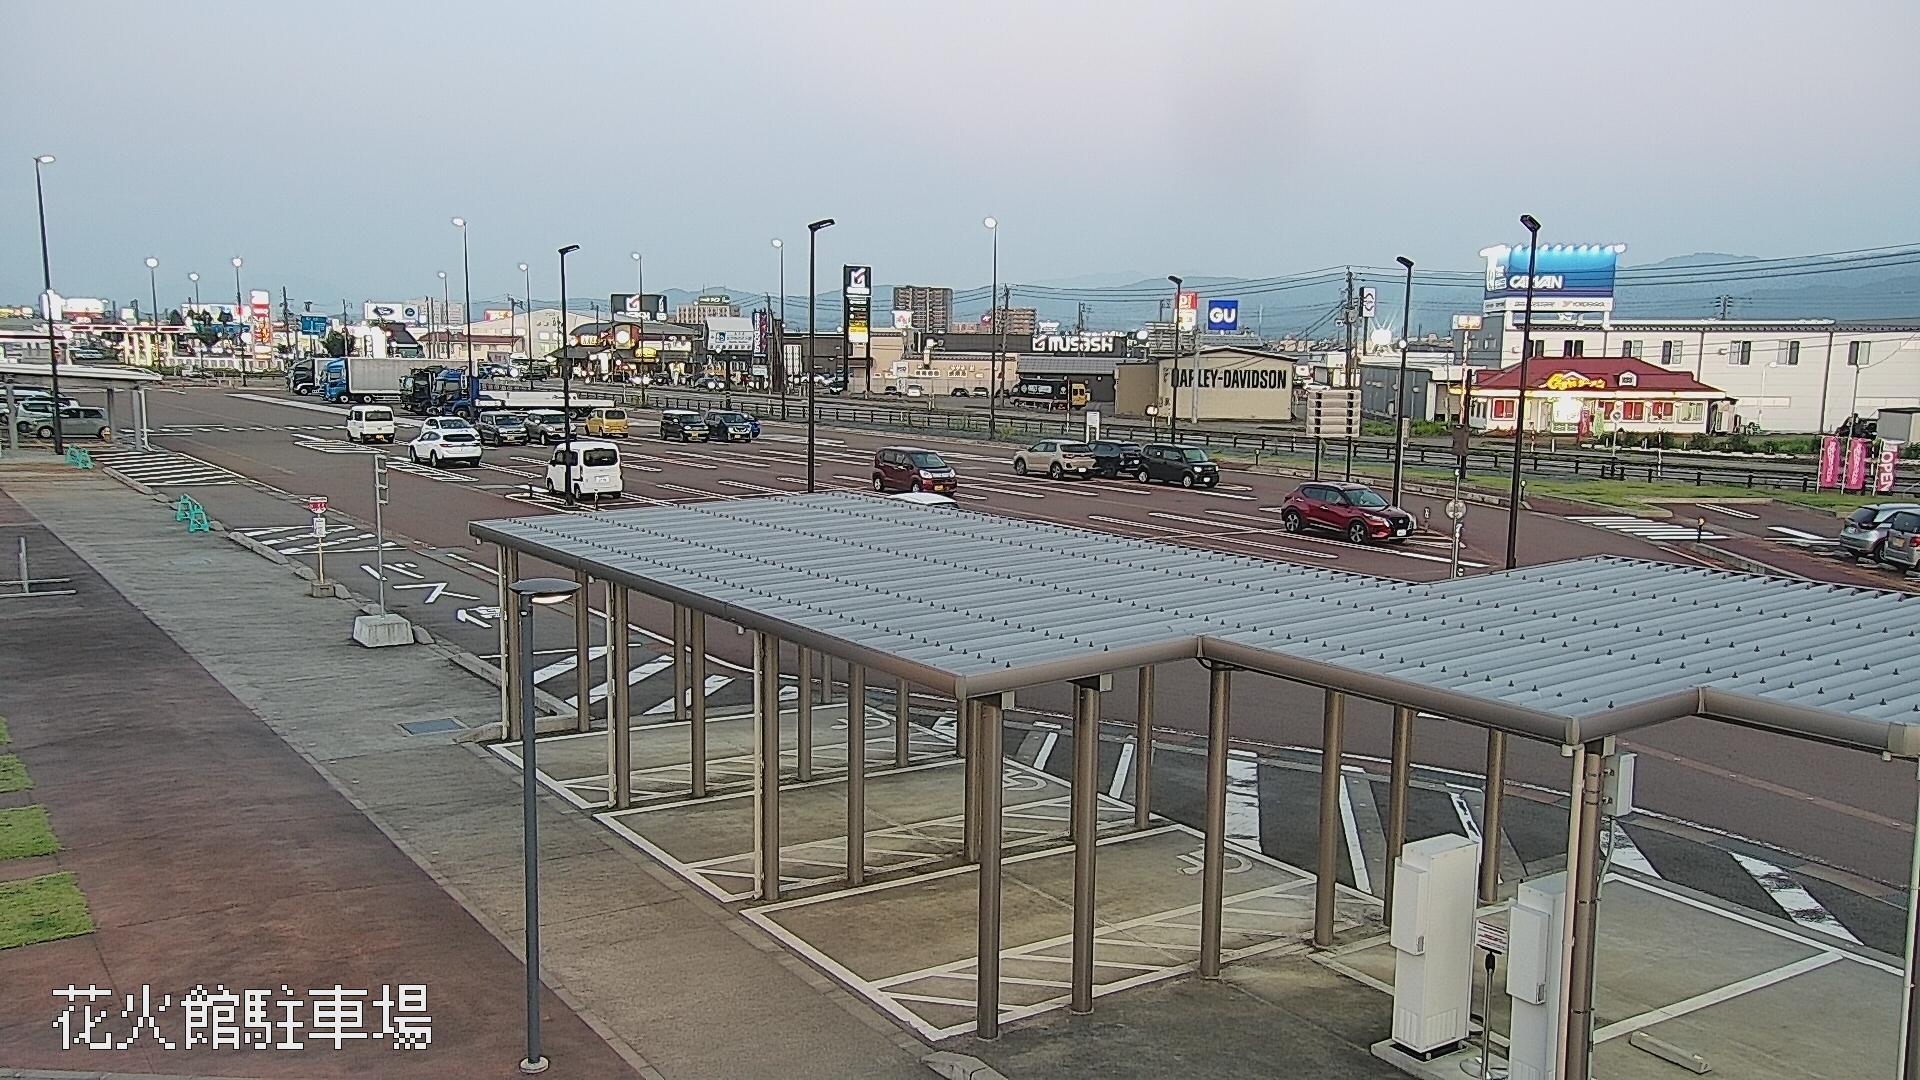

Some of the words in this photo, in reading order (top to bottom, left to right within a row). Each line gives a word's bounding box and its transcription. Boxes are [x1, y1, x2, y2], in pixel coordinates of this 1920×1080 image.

[1209, 307, 1236, 323] GU
[1171, 368, 1287, 389] ARLEY-DAVIDSON
[1879, 451, 1894, 492] OPEN
